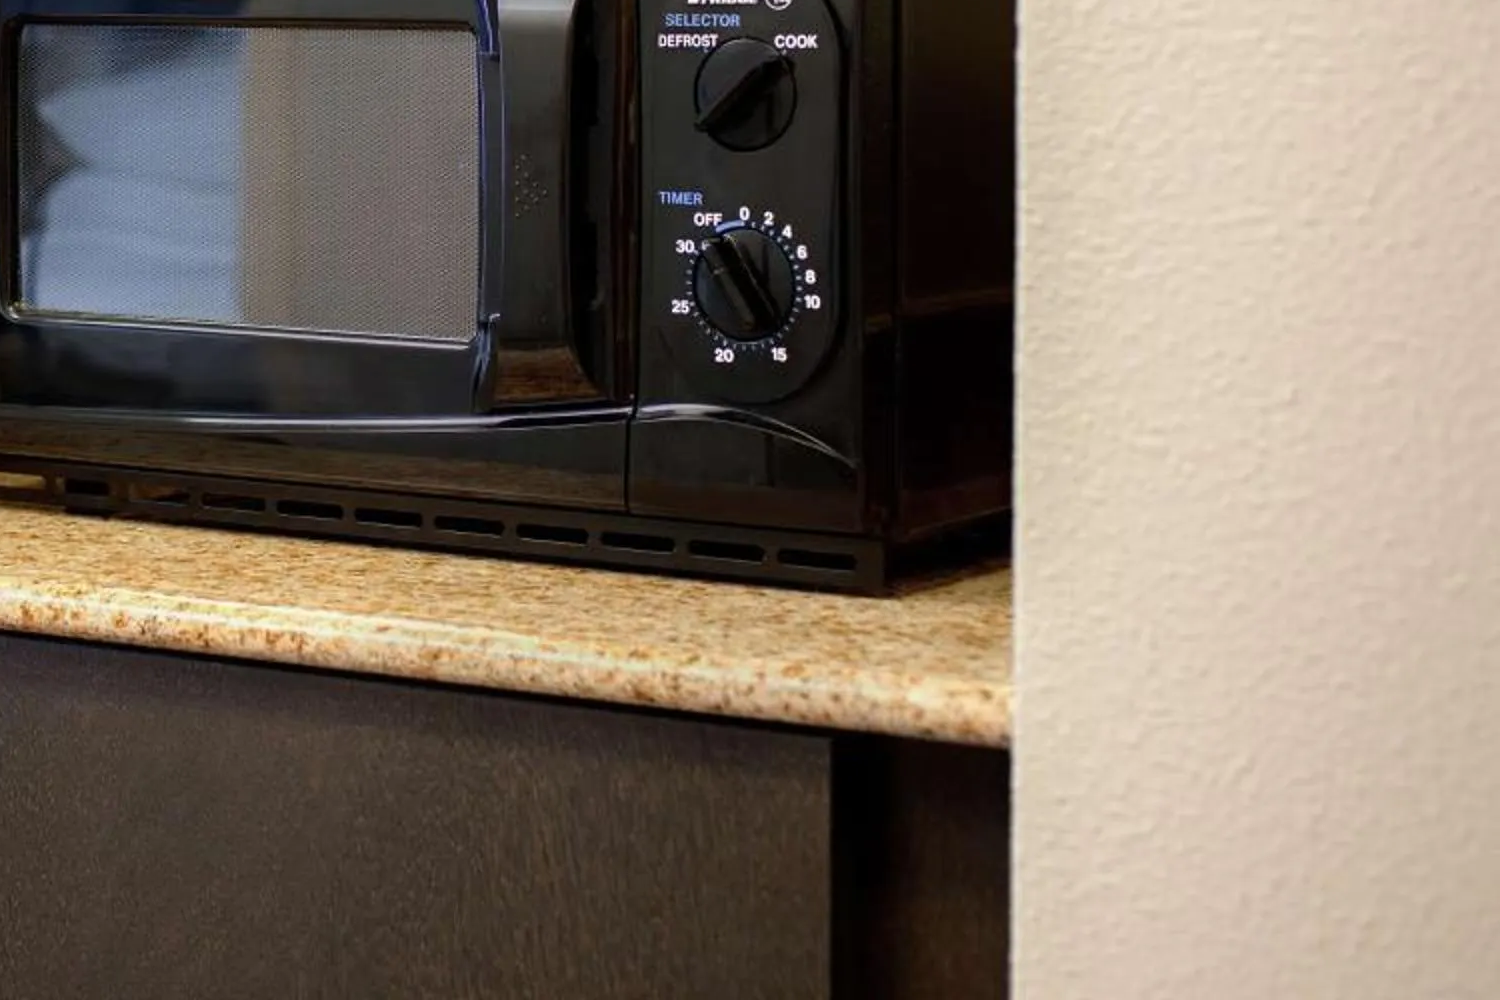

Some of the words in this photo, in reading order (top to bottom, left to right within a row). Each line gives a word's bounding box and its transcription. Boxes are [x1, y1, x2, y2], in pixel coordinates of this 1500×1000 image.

[665, 13, 741, 27] SELECTOR
[658, 33, 719, 47] DEFROST
[774, 34, 818, 49] COOK
[659, 191, 703, 205] TIMER
[693, 212, 723, 227] OFF
[739, 206, 750, 221] 0
[763, 211, 774, 226] 2
[781, 224, 793, 239] 4
[675, 239, 695, 253] 30
[796, 245, 808, 260] 6
[804, 269, 816, 284] 8
[671, 299, 691, 314] 25
[803, 294, 821, 309] 10
[714, 348, 735, 363] 20
[771, 347, 788, 362] 15
